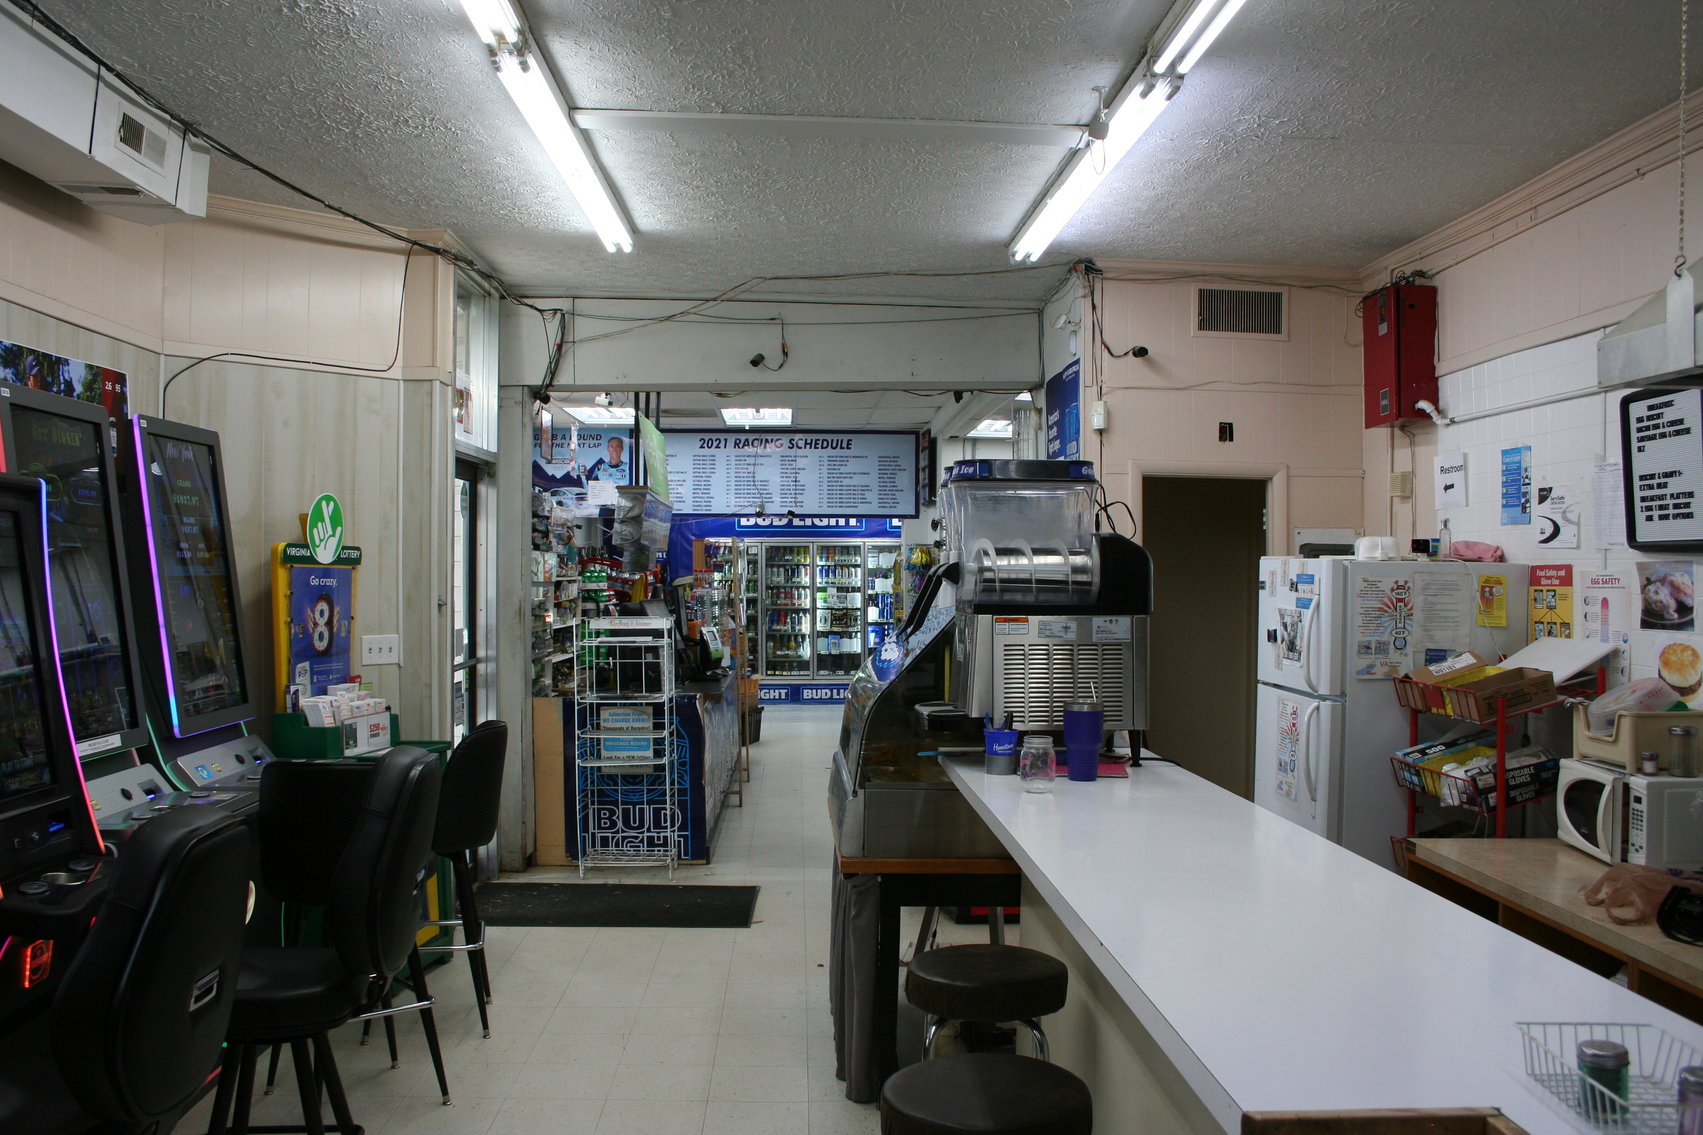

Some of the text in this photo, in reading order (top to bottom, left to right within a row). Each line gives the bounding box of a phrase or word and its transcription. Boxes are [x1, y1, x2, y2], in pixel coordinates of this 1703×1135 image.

[698, 438, 854, 451] 2021 RACING SCHEDULE
[1639, 483, 1655, 491] EXTRA
[1640, 491, 1694, 503] BREAKFAST PLATTERS
[1672, 512, 1693, 520] OPTIONS
[287, 548, 360, 558] VIRGINIA LOTTERY
[1536, 569, 1565, 578] Food Safety and
[310, 576, 338, 588] Go crazy.
[758, 689, 788, 699] IGHT
[803, 689, 831, 699] BUD
[1425, 745, 1446, 754] 500
[1509, 775, 1530, 785] GLOVES
[590, 805, 682, 832] BUD
